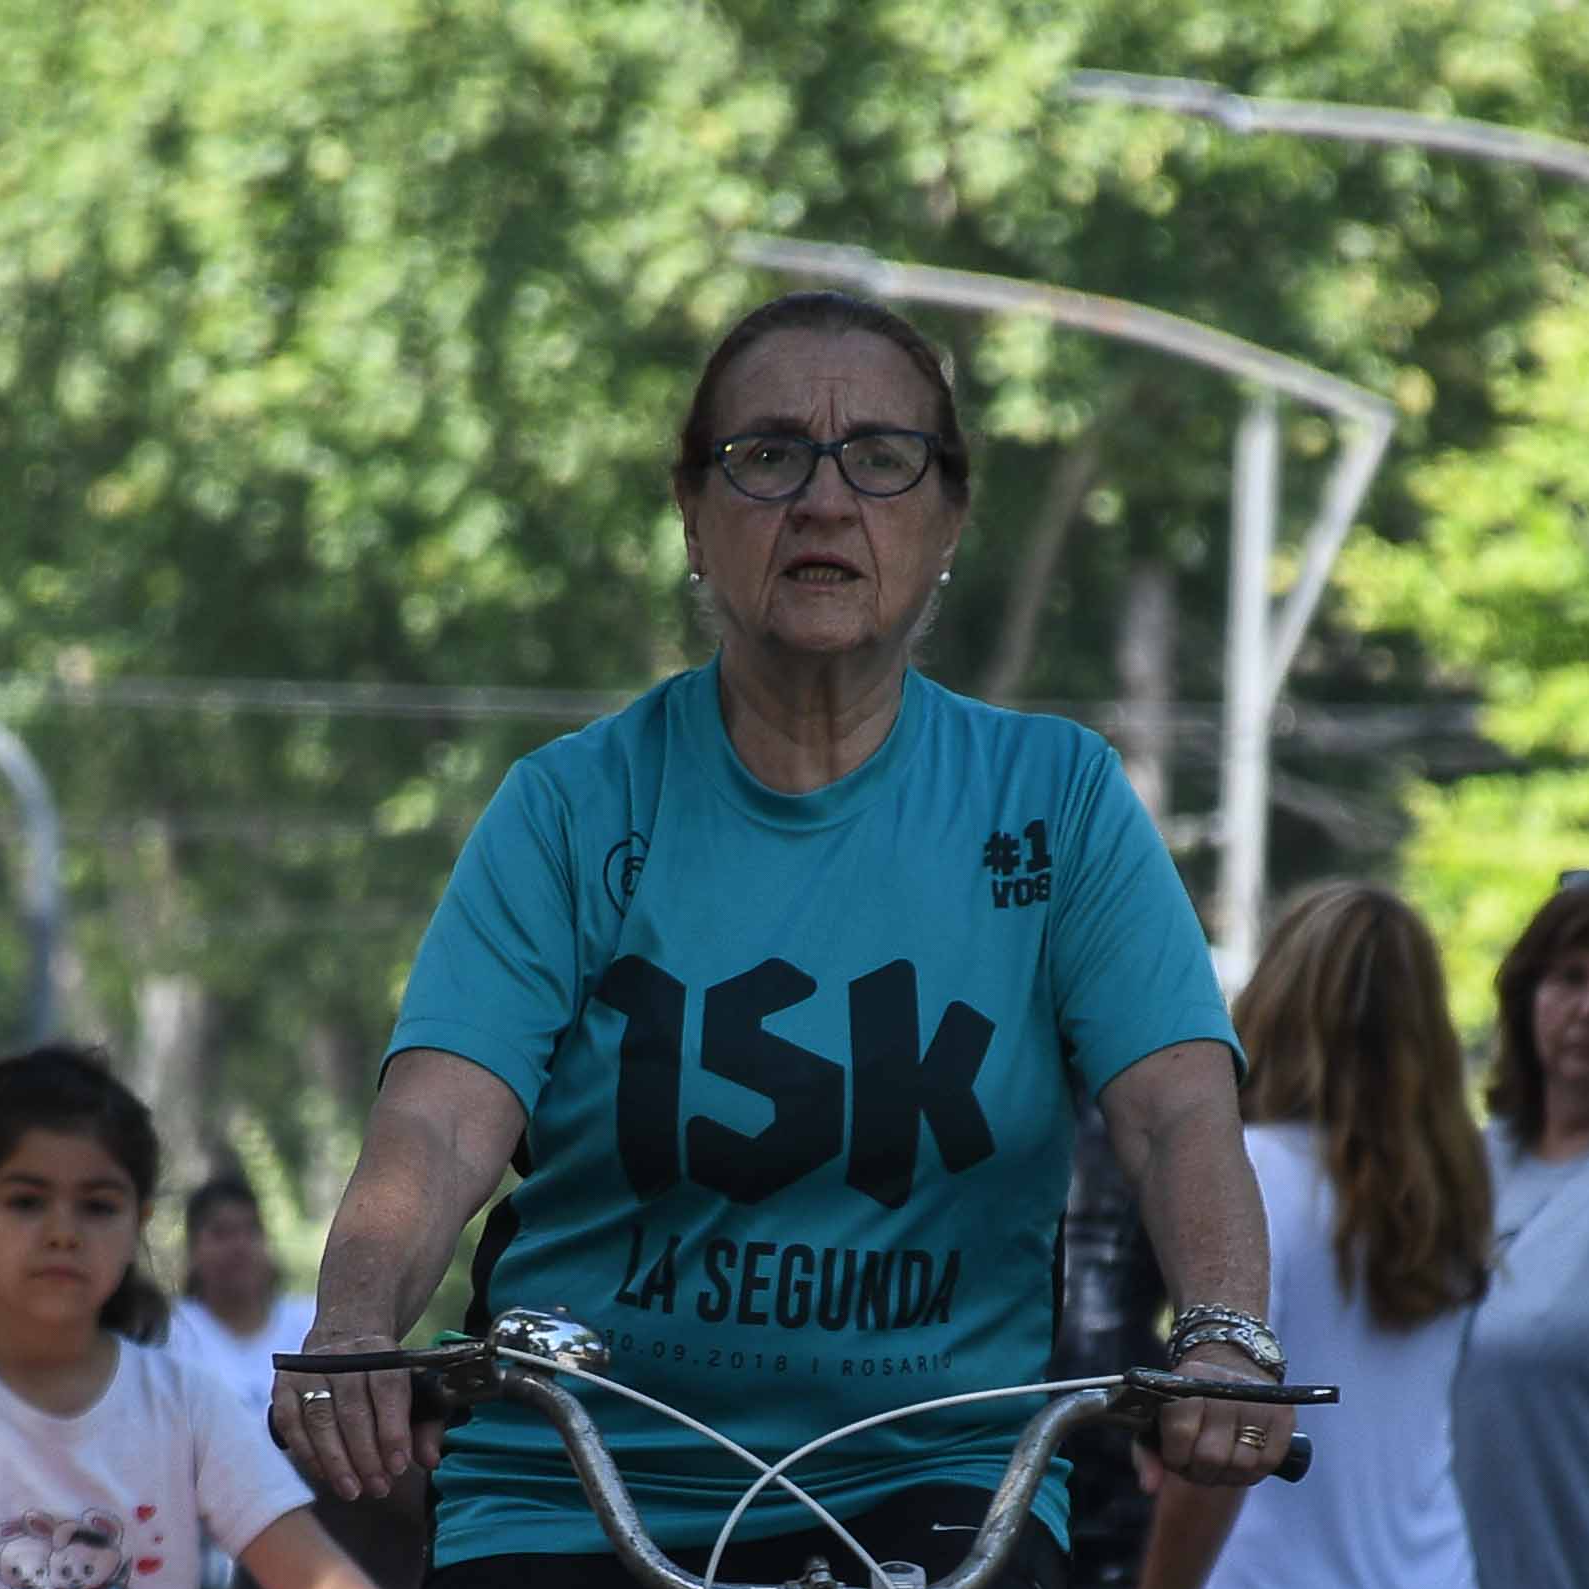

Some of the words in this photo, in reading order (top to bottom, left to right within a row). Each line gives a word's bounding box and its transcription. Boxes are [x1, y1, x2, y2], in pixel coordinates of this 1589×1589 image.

[983, 818, 1052, 876] #1
[992, 872, 1052, 909] VOS
[614, 1225, 682, 1315] LA
[697, 1238, 961, 1332] SEGUNDA
[841, 1351, 953, 1377] ROSARIO
